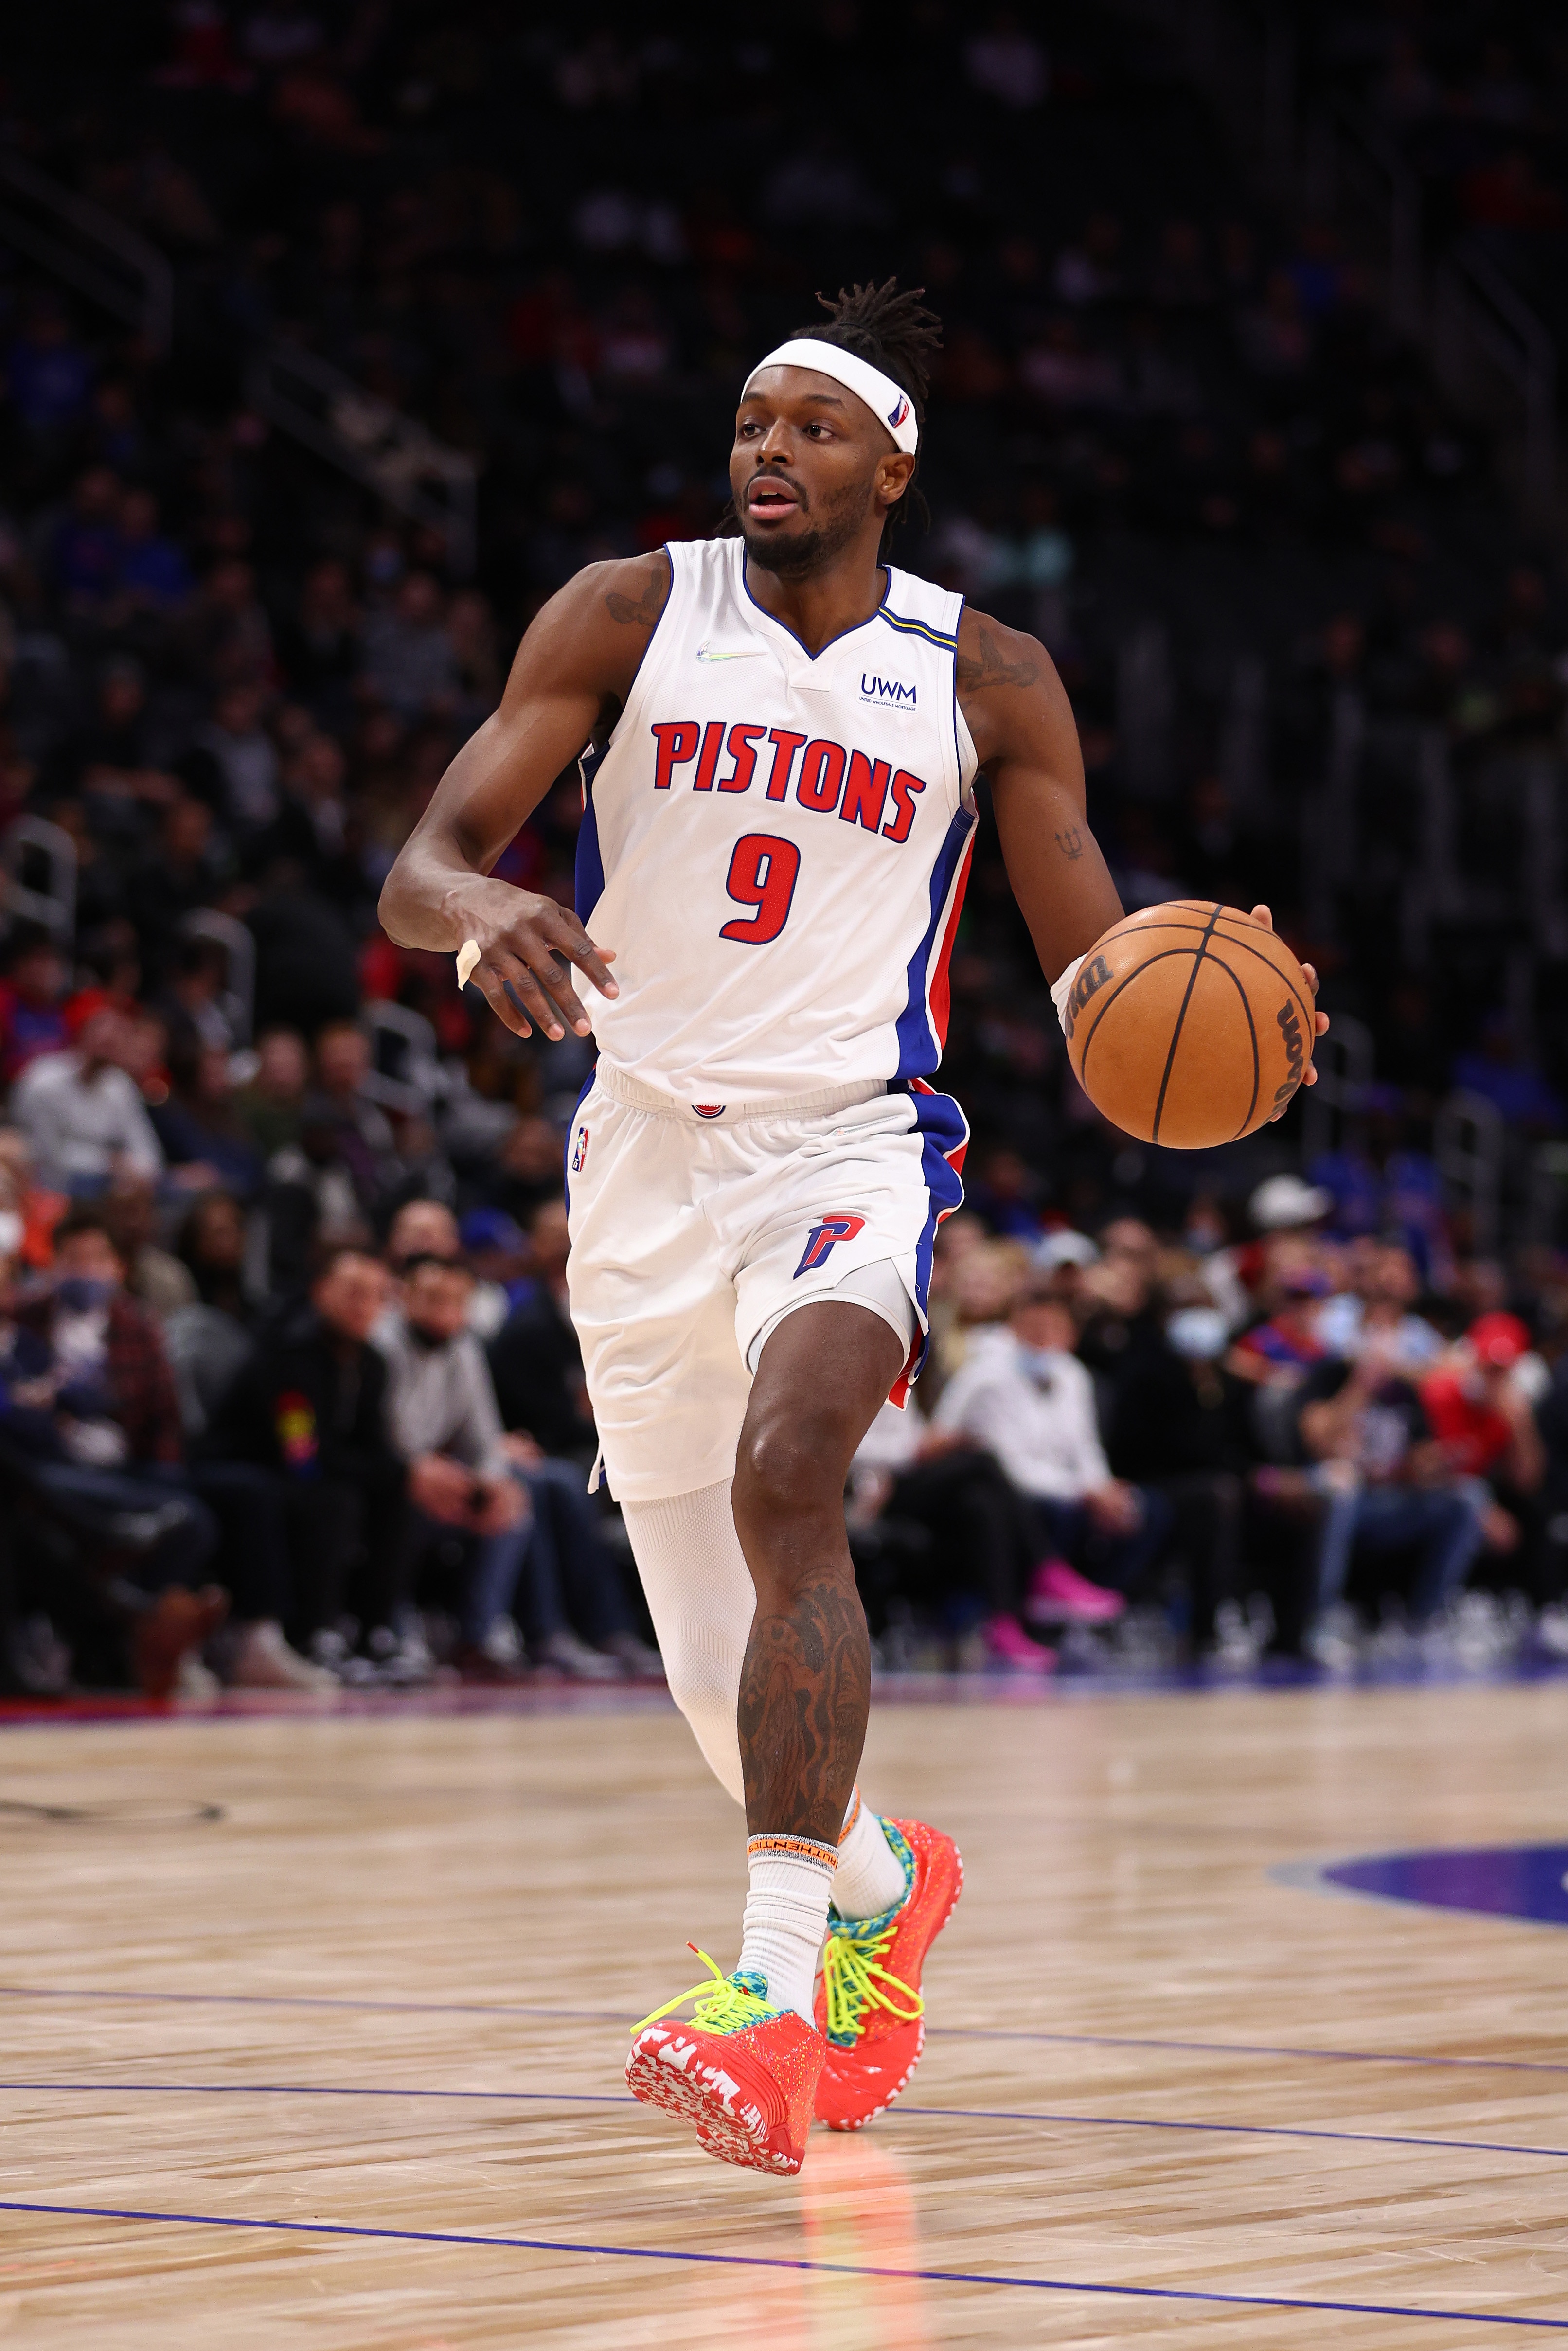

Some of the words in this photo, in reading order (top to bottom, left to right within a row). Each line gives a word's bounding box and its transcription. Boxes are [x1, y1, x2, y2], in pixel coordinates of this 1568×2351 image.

[861, 673, 916, 704] UWM
[651, 721, 926, 844] PISTONS
[719, 833, 801, 945] 9
[793, 1215, 866, 1280] P
